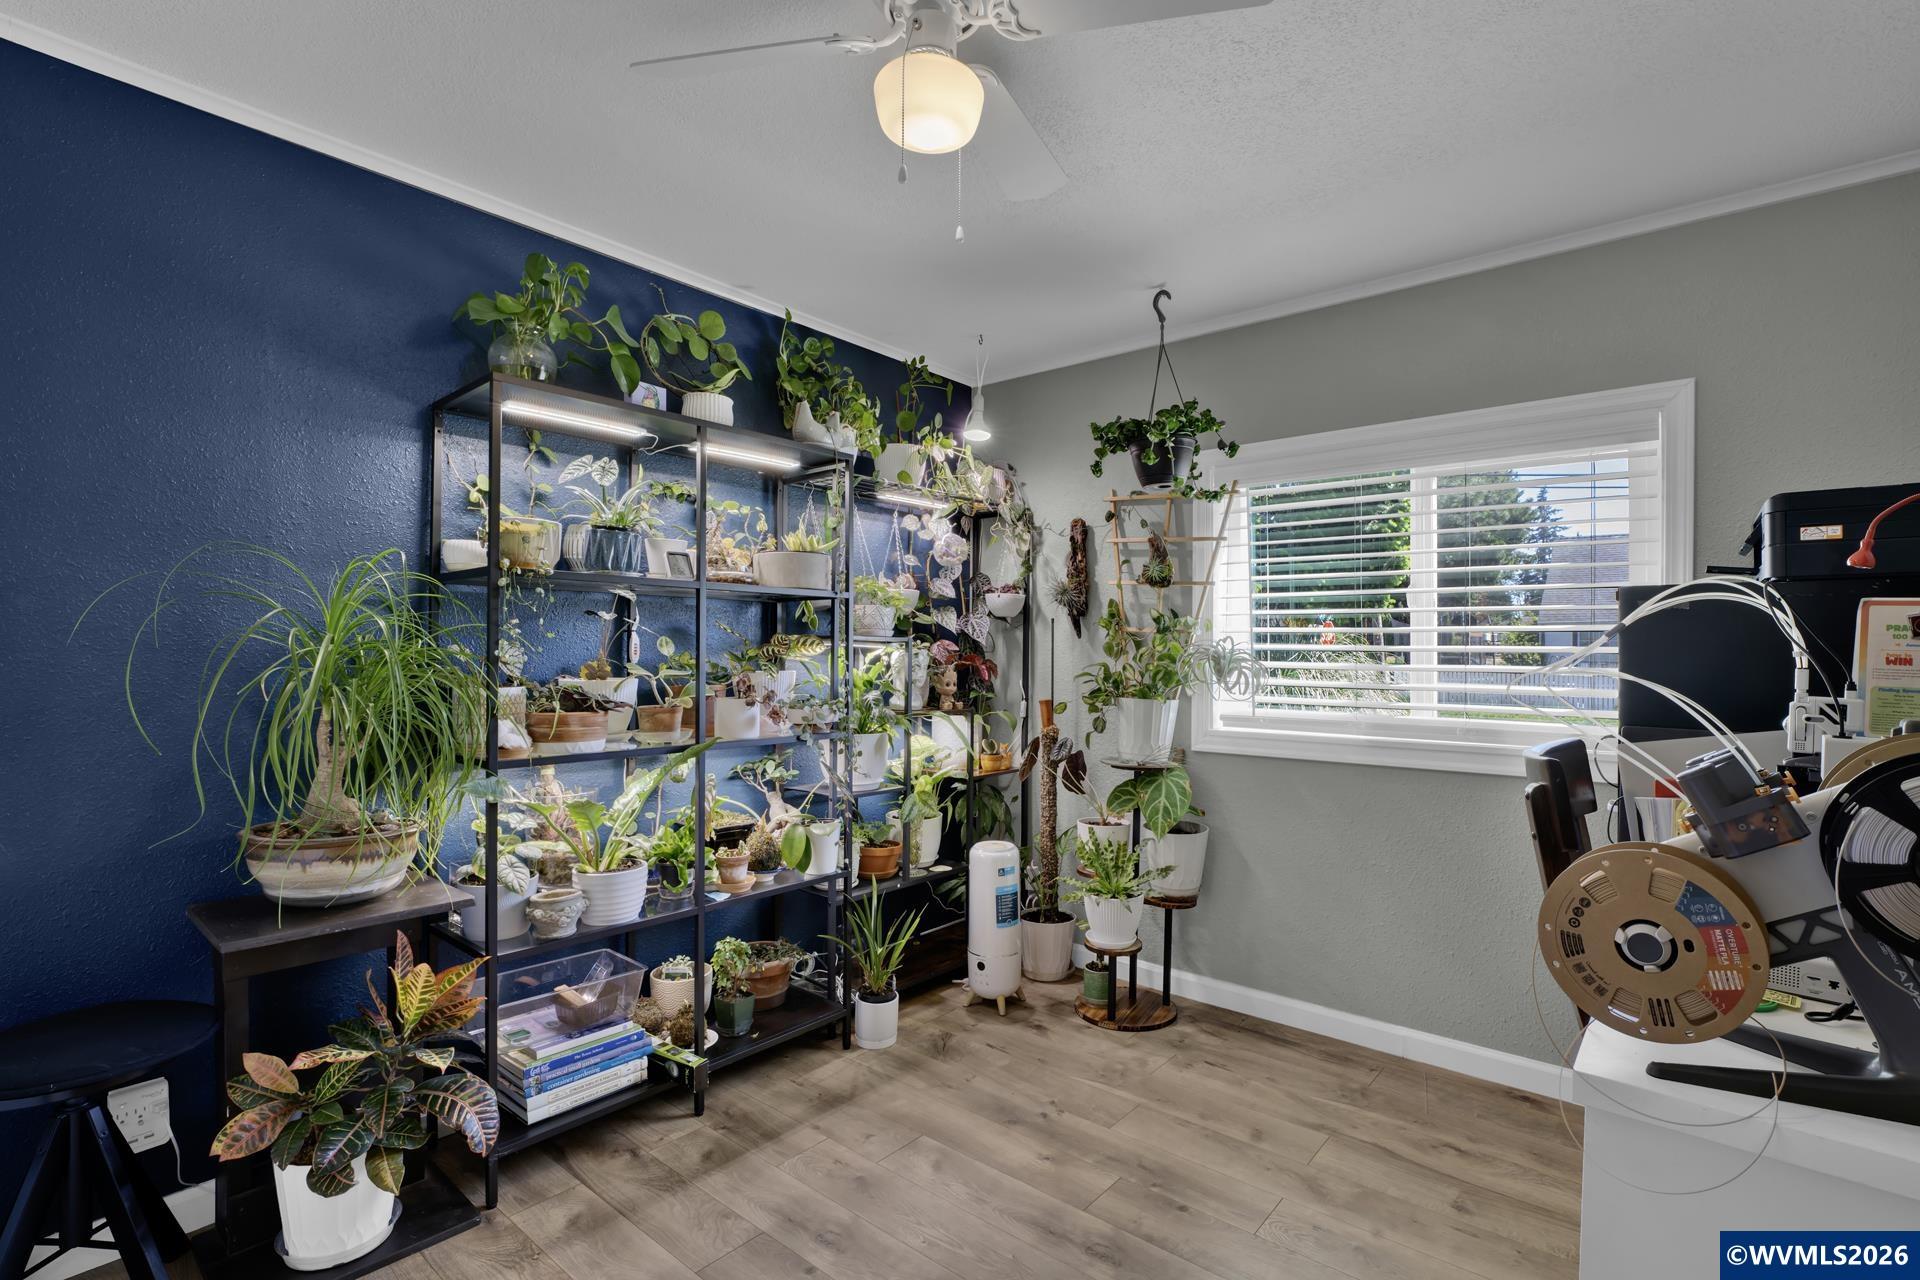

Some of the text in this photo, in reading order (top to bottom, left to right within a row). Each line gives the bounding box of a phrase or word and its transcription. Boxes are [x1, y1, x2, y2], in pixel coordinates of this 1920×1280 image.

[1886, 624, 1909, 632] PRA
[1885, 656, 1914, 666] WIN
[1714, 929, 1727, 951] MATTE
[1725, 928, 1741, 965] OVERTURE
[1720, 952, 1730, 965] PLA
[547, 1075, 573, 1090] container
[574, 1065, 601, 1081] gardening
